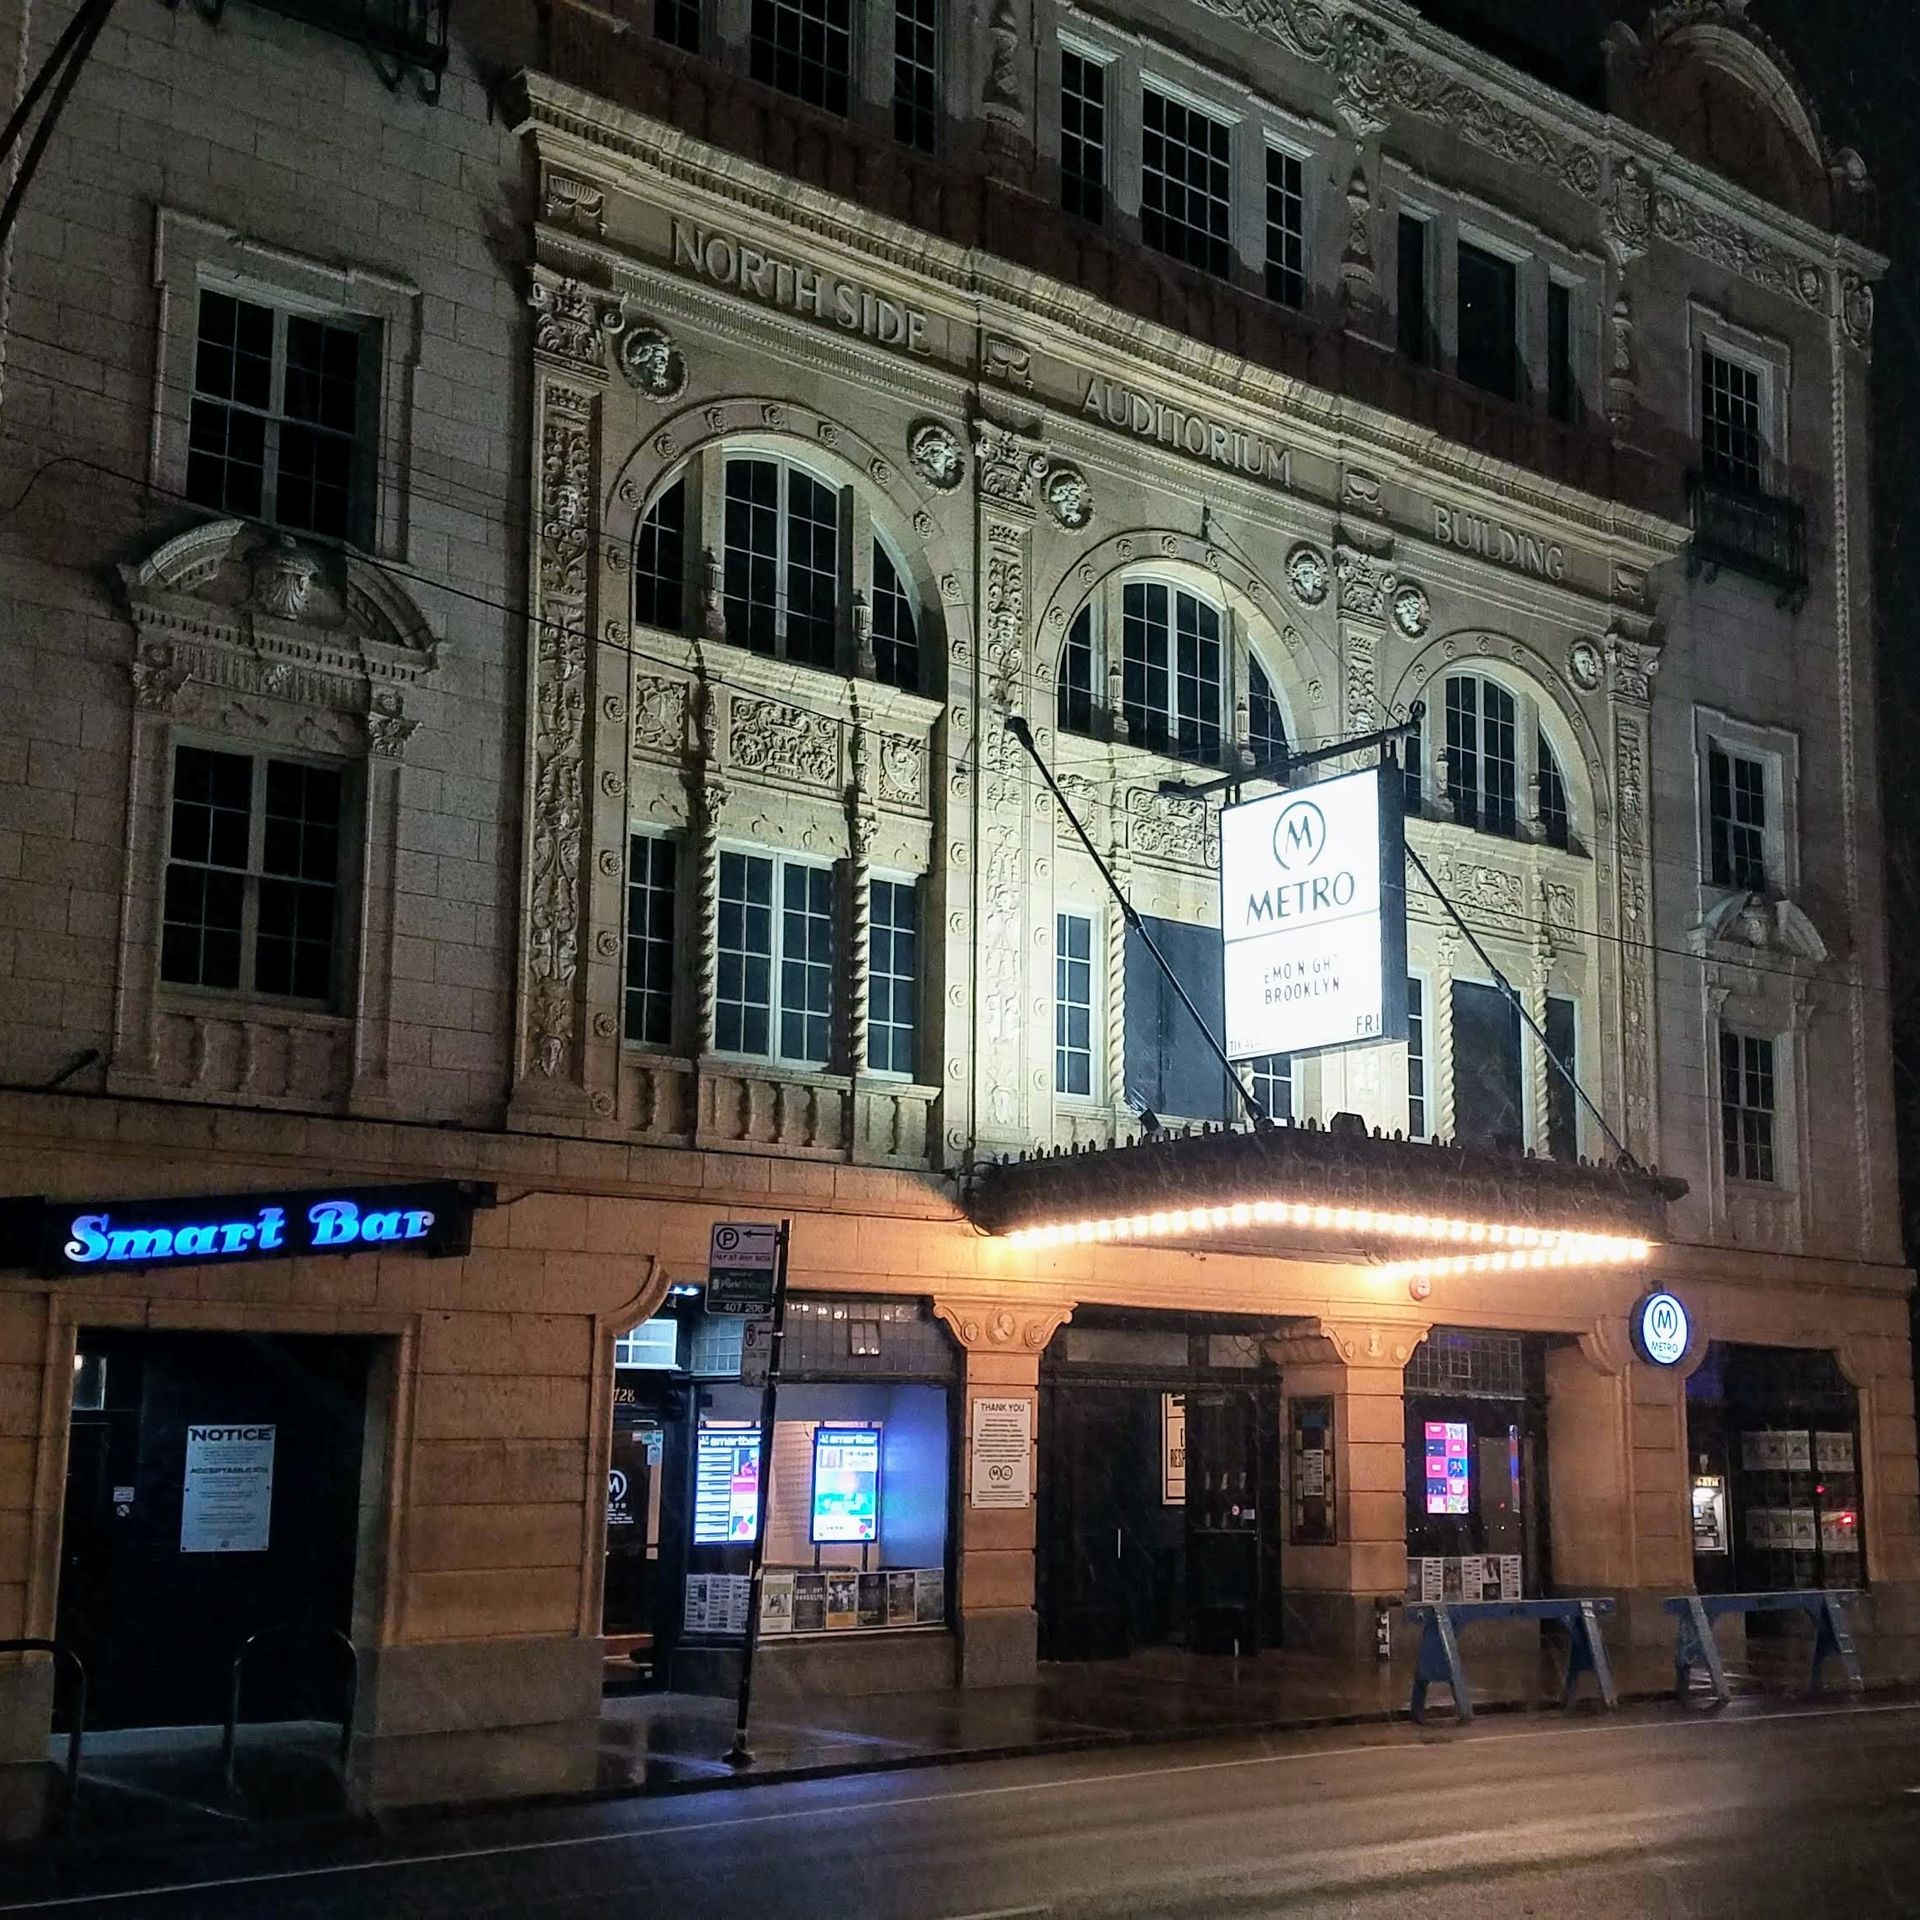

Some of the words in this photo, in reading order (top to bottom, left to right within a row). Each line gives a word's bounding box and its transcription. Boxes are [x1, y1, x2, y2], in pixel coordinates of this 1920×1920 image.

[670, 219, 824, 318] NORTH
[834, 281, 931, 357] SIDE
[1082, 377, 1292, 489] AUDITORIUM
[1432, 503, 1565, 580] BUILDING
[1246, 871, 1355, 927] METRO
[1264, 975, 1340, 1006] BROOKLYN
[1355, 1012, 1380, 1035] FRI
[63, 1206, 285, 1264] Smart
[308, 1200, 436, 1247] Bar
[1651, 1340, 1679, 1354] METRO
[980, 1402, 1007, 1413] THANK
[1008, 1402, 1025, 1413] YOU
[190, 1428, 273, 1442] NOTICE
